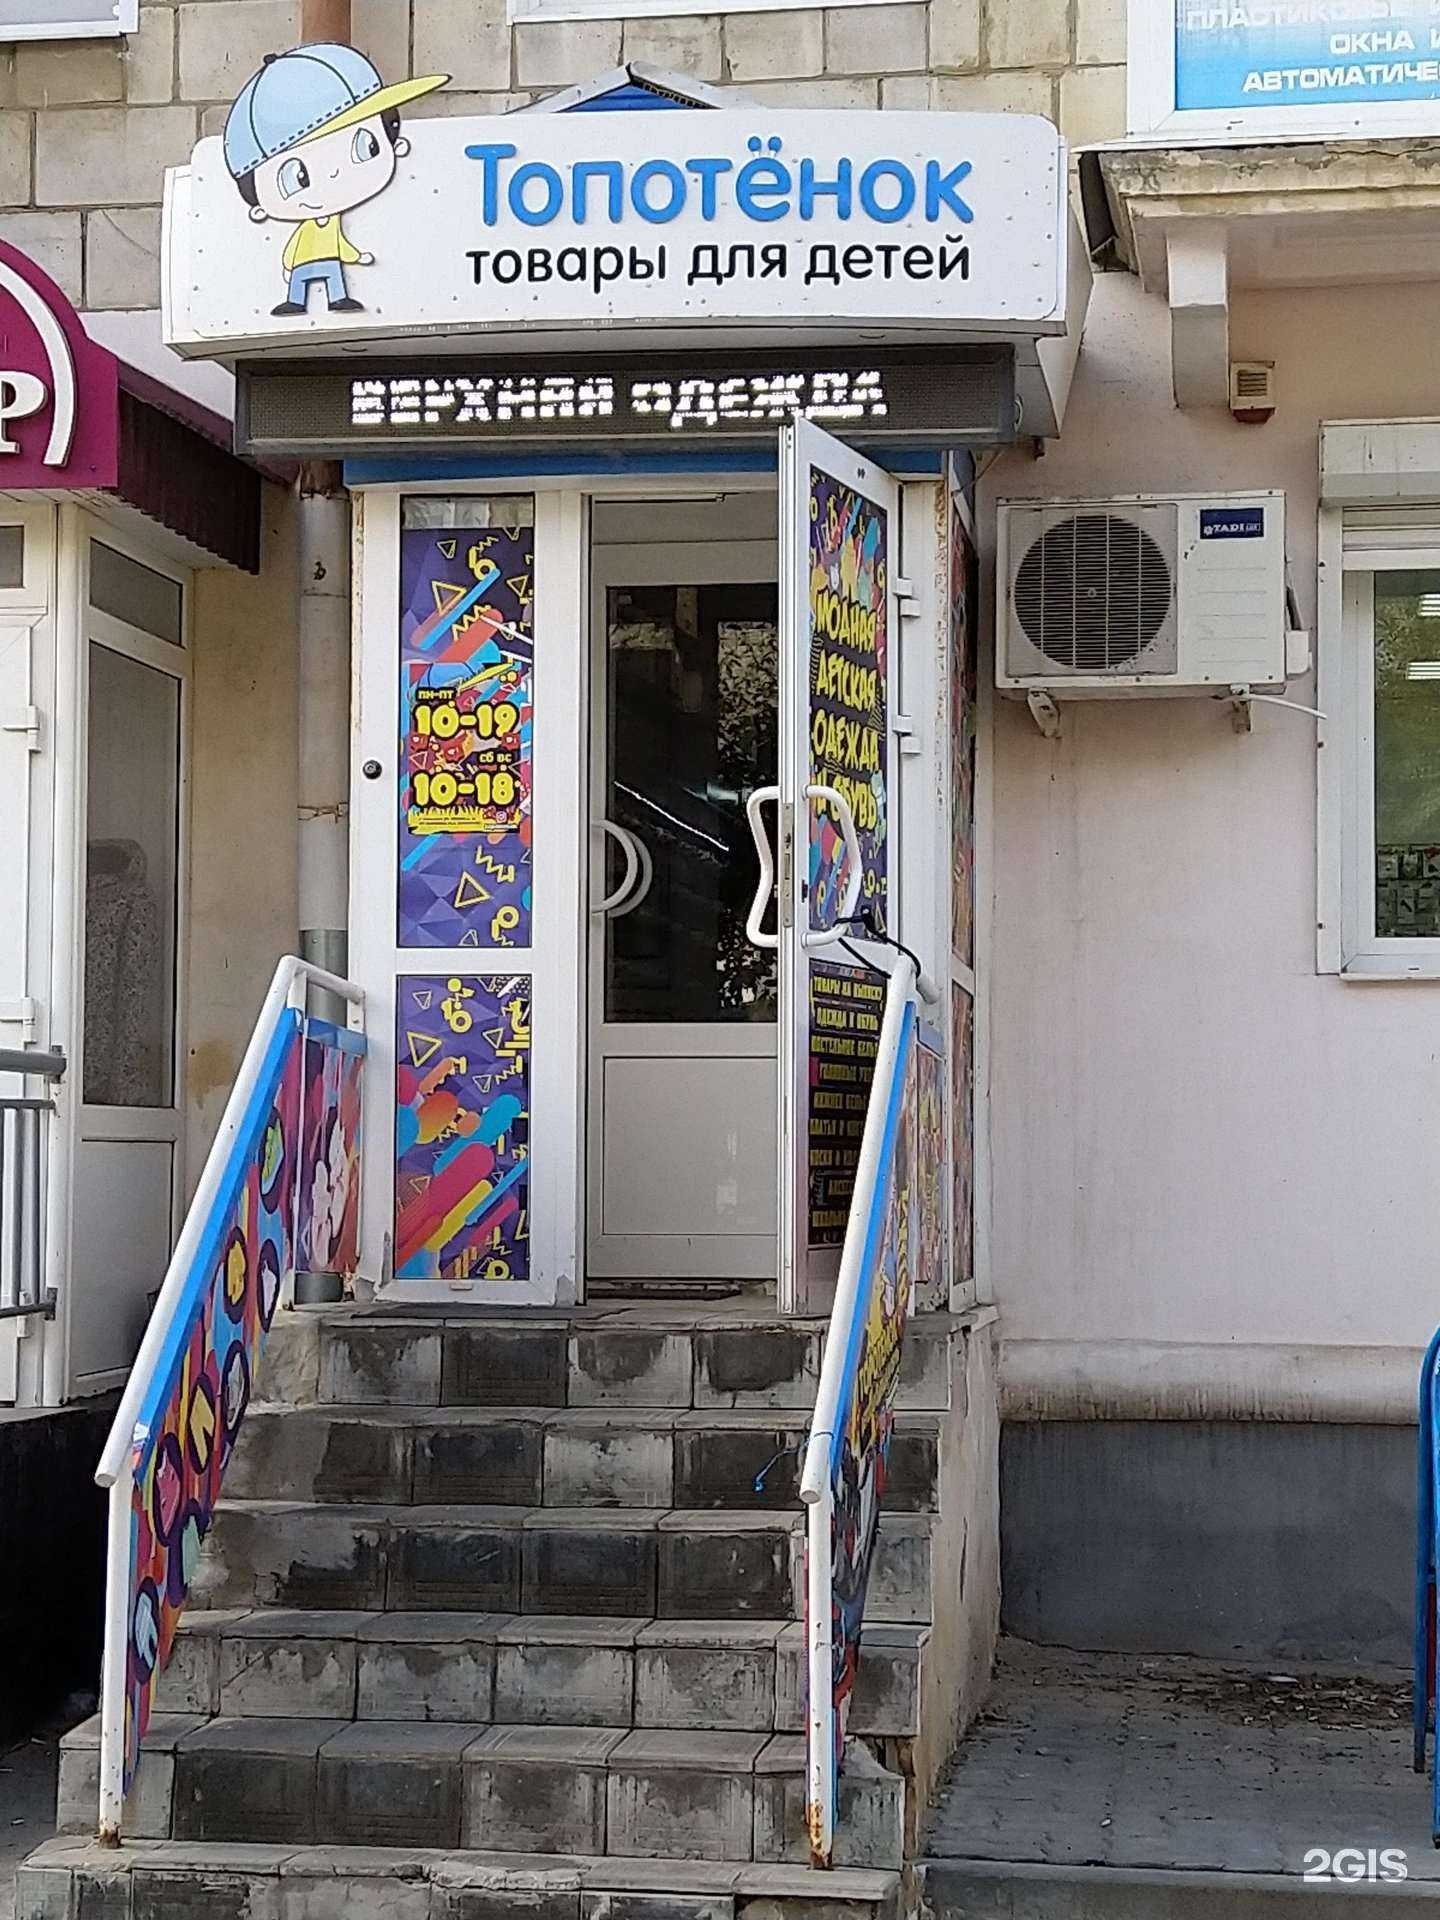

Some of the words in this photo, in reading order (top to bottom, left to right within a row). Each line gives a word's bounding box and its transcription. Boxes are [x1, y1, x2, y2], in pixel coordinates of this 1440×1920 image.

[1330, 30, 1415, 54] ОКНА
[1243, 61, 1440, 92] АВТОМАТИЧЕ
[465, 136, 974, 226] Топотёнок
[466, 245, 665, 293] товары
[687, 245, 787, 284] для
[805, 235, 969, 284] детей
[816, 590, 877, 653] МОДНАЯ
[816, 649, 877, 712] ДЕТСКАЯ
[415, 704, 517, 738] 10-19
[814, 709, 880, 771] ОДЕЖДА
[414, 772, 515, 806] 10-18
